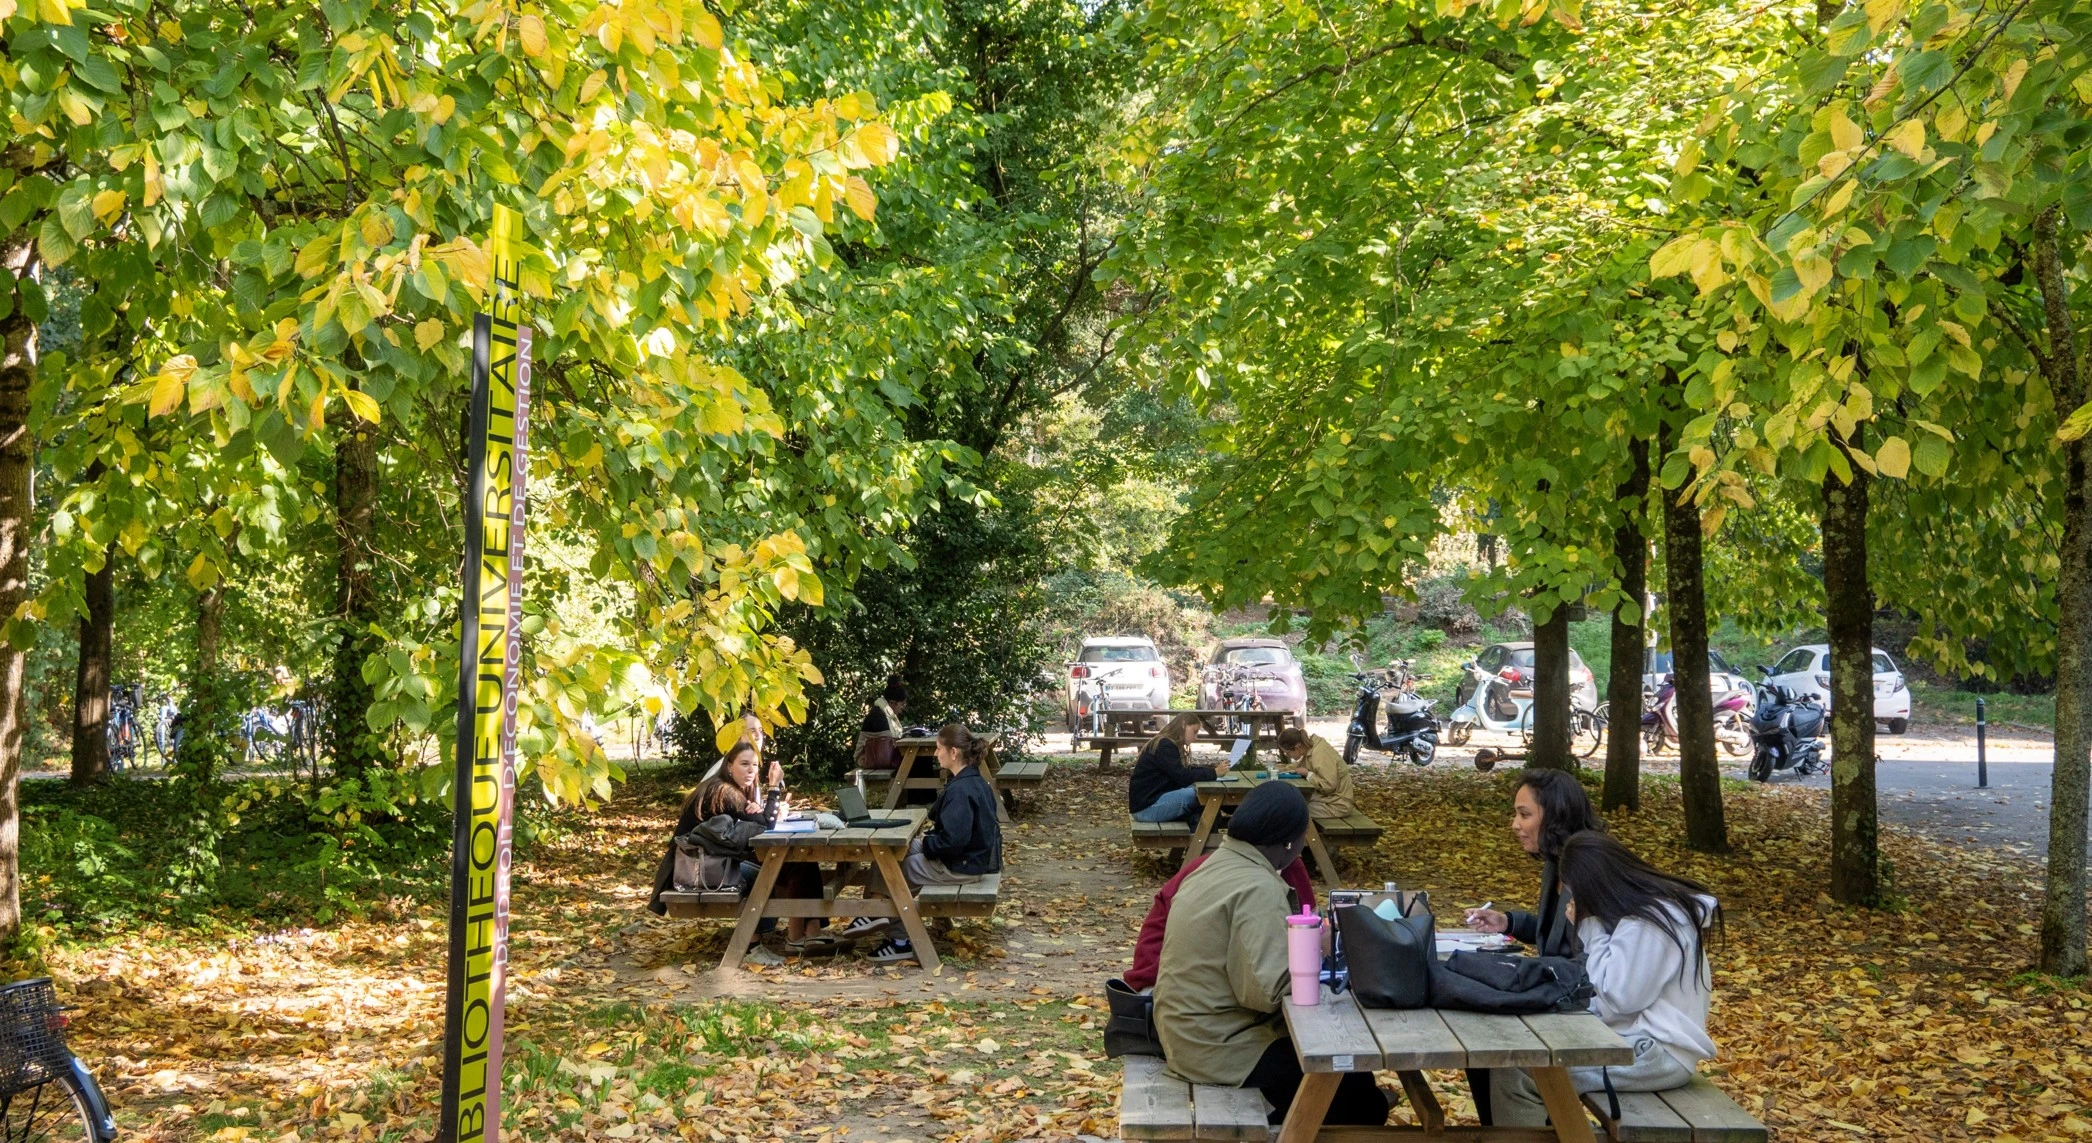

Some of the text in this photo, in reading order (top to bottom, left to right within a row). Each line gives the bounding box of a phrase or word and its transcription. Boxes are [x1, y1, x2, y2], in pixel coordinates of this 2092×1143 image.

[516, 337, 533, 476] GESTION
[477, 254, 520, 715] UNIVERSITAIRE
[513, 484, 526, 527] DE
[511, 534, 525, 571] ET
[503, 582, 522, 790] D'ECONOMIE
[498, 818, 513, 918] DROIT
[496, 925, 508, 966] DE
